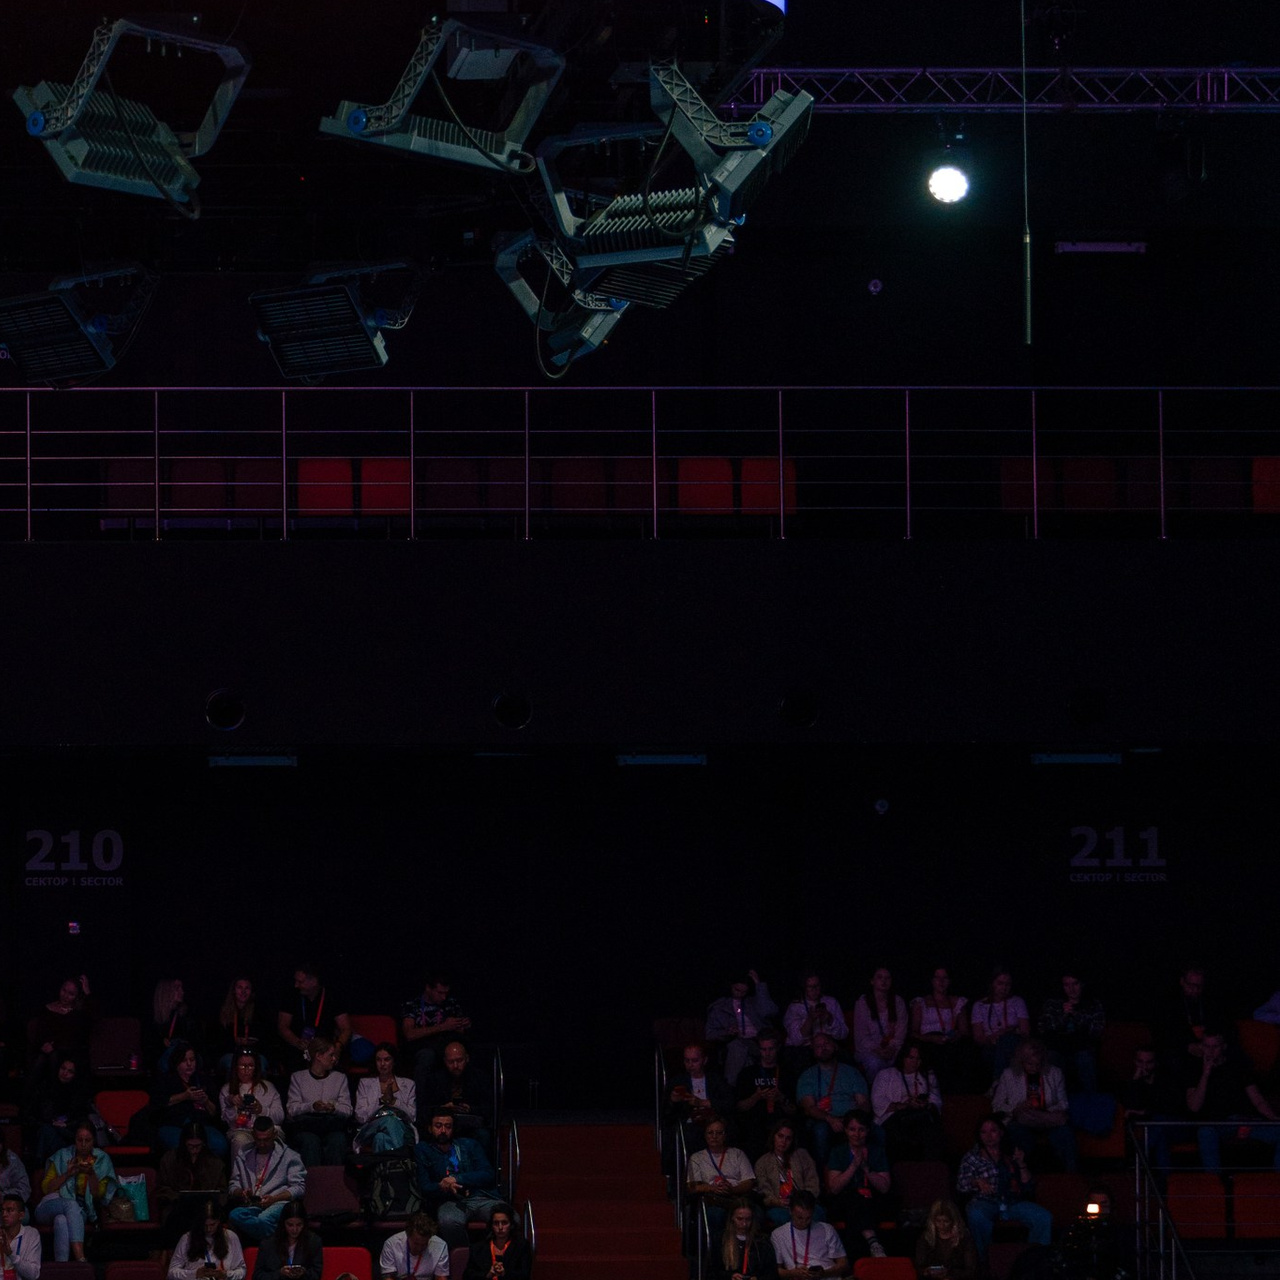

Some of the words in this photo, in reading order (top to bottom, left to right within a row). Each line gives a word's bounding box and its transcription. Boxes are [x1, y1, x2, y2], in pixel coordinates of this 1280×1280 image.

[24, 828, 124, 872] 210
[1069, 824, 1168, 868] 211
[24, 876, 69, 887] СЕКТОР
[79, 876, 124, 887] SECTOR
